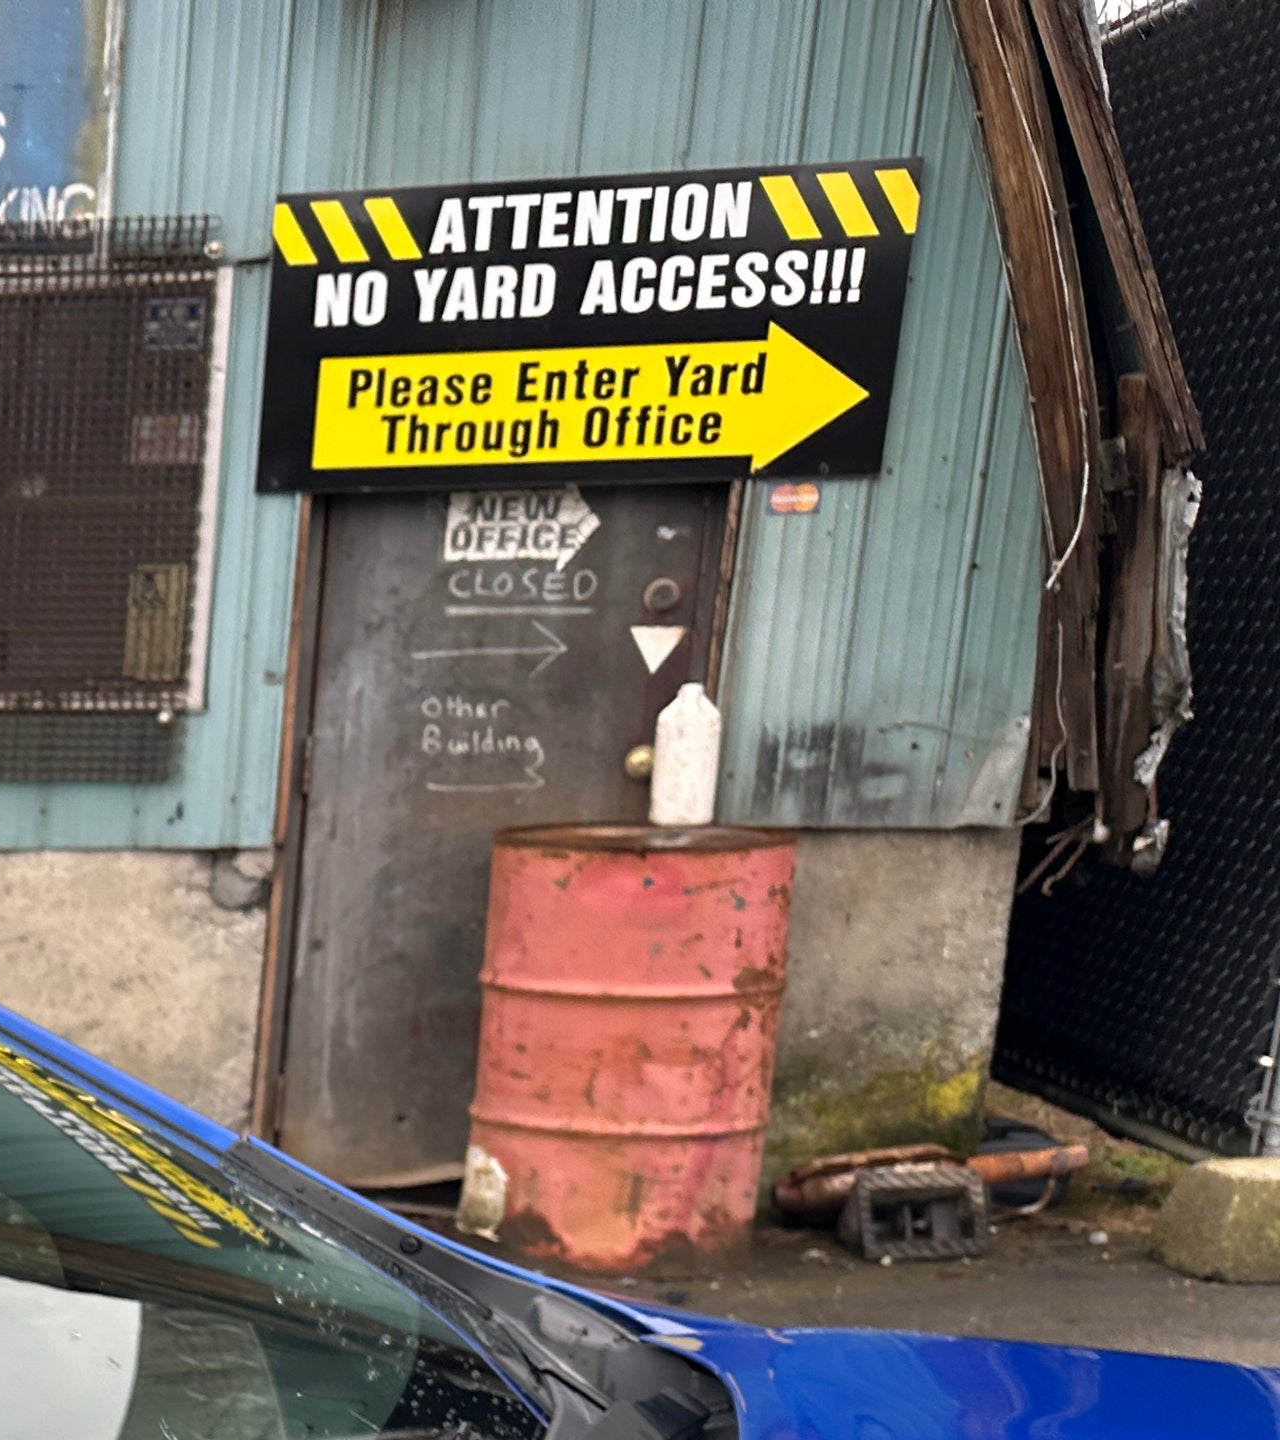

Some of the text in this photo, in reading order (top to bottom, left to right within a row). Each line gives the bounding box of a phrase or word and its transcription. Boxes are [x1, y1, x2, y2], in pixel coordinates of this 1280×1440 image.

[429, 181, 753, 254] ATTENTION
[314, 248, 867, 327] NO YARD ACCESS!!!
[347, 353, 767, 410] Please Enter Yard
[381, 407, 724, 458] Through Office
[472, 496, 562, 521] NEW
[448, 568, 598, 600] CLOSED
[421, 695, 511, 719] Other
[421, 723, 545, 768] Building
